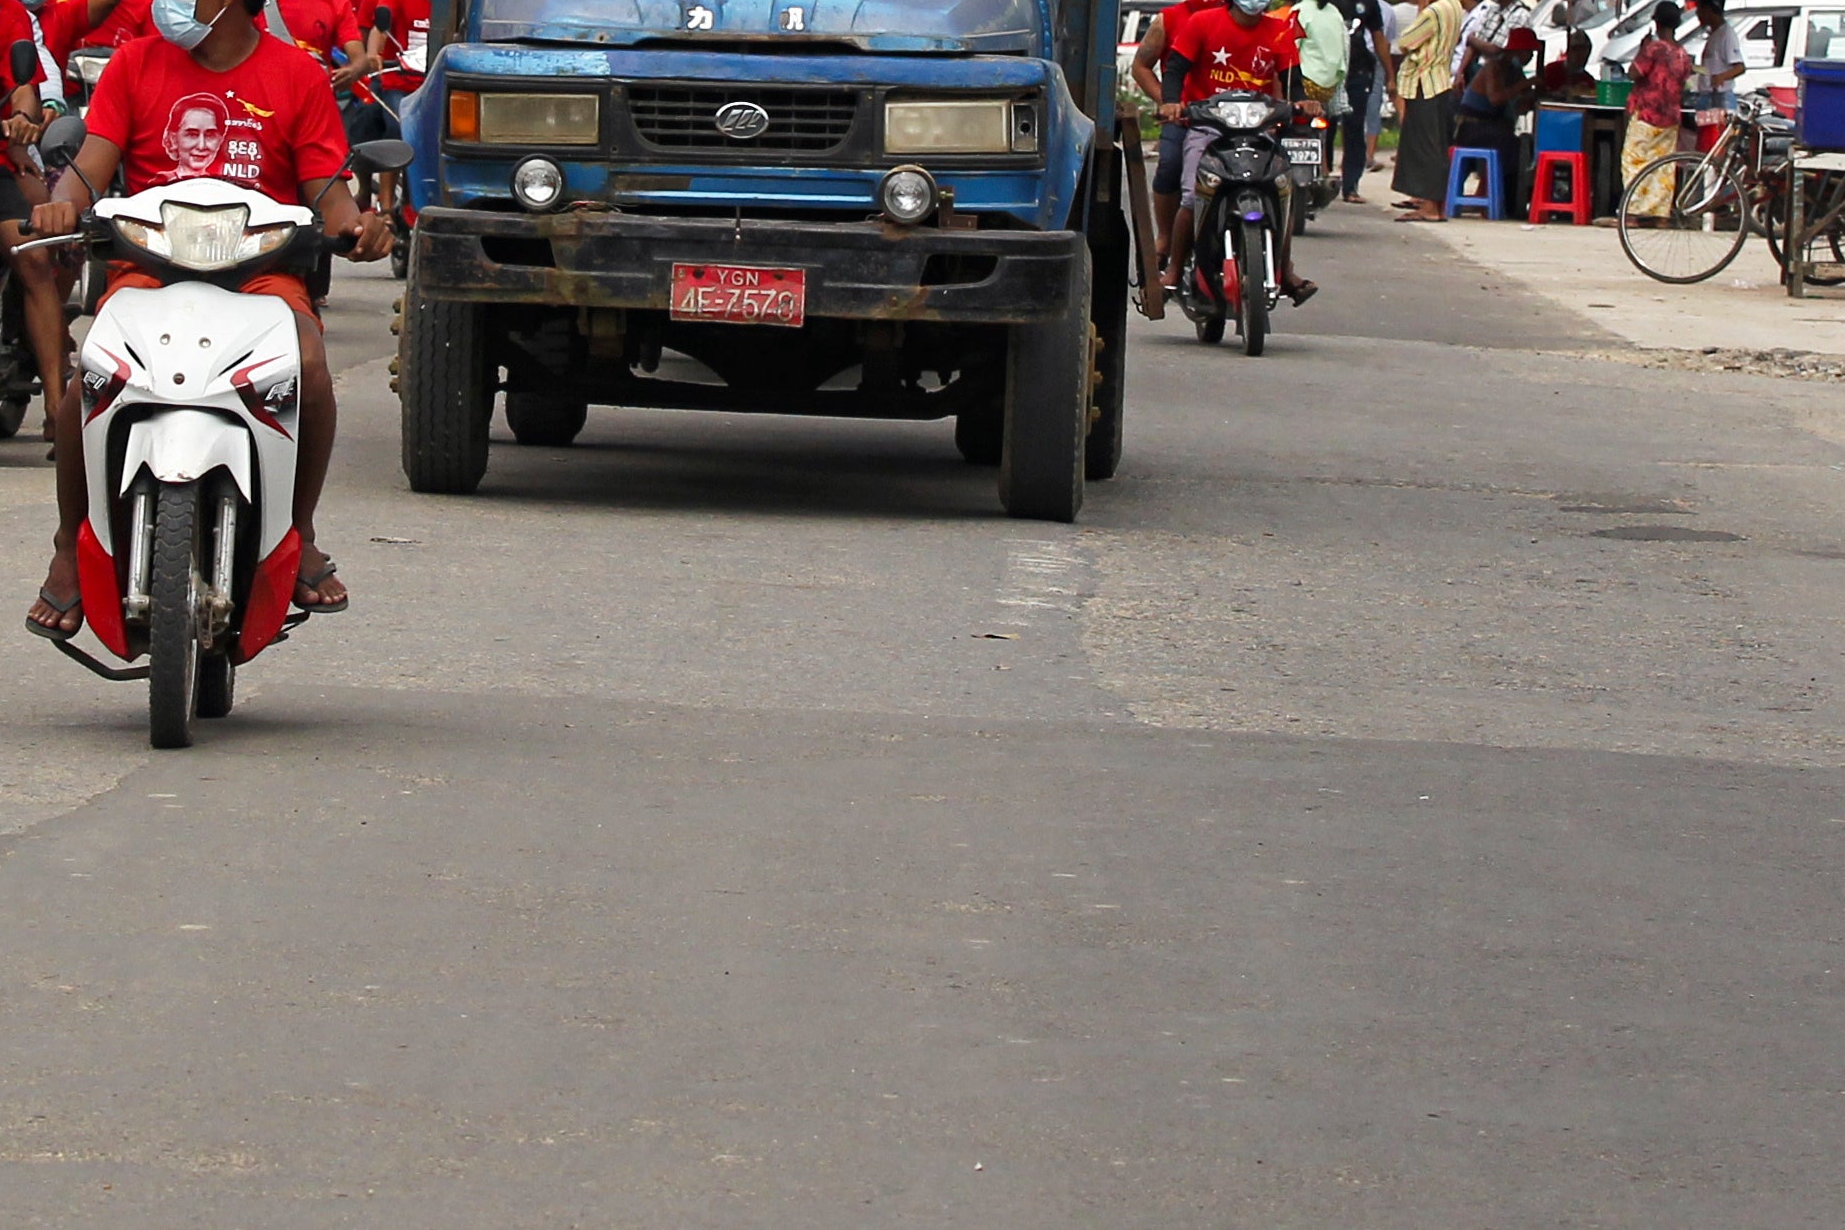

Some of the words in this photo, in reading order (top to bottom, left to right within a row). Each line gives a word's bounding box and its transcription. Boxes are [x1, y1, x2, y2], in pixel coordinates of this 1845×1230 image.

[687, 6, 714, 30] 力
[1209, 69, 1235, 83] NLD
[223, 163, 260, 179] NLD
[716, 270, 759, 286] YGN
